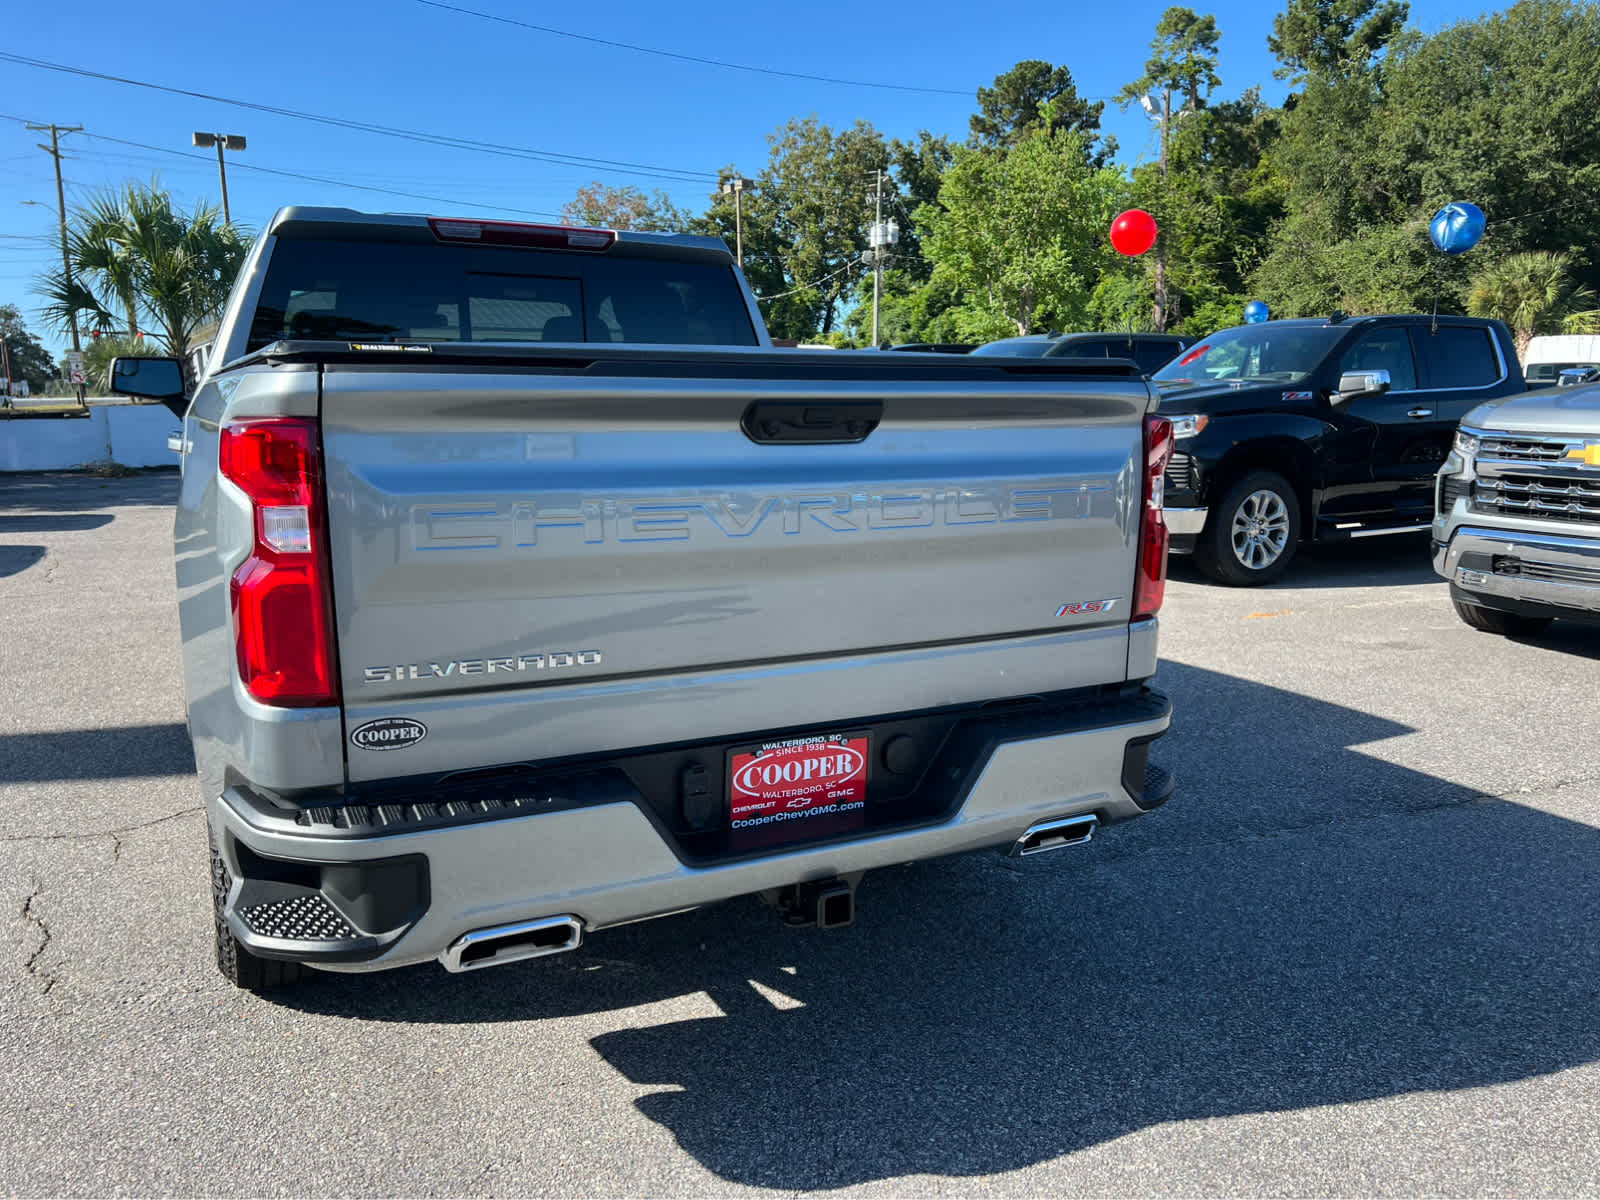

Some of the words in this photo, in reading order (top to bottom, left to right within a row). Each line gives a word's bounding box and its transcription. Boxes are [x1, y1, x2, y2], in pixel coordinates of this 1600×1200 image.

[410, 481, 1111, 550] CHEVROLET
[1055, 597, 1122, 617] RST
[364, 650, 601, 684] SILVERADO
[358, 727, 420, 743] COOPER
[829, 734, 842, 742] SC
[776, 747, 803, 757] SINCE
[806, 744, 825, 752] 1938
[743, 753, 853, 788] COOPER
[825, 781, 837, 789] SC
[827, 788, 854, 798] GMC
[732, 801, 776, 813] CHEVROLET
[732, 801, 864, 828] CooperChevyGMC.com
